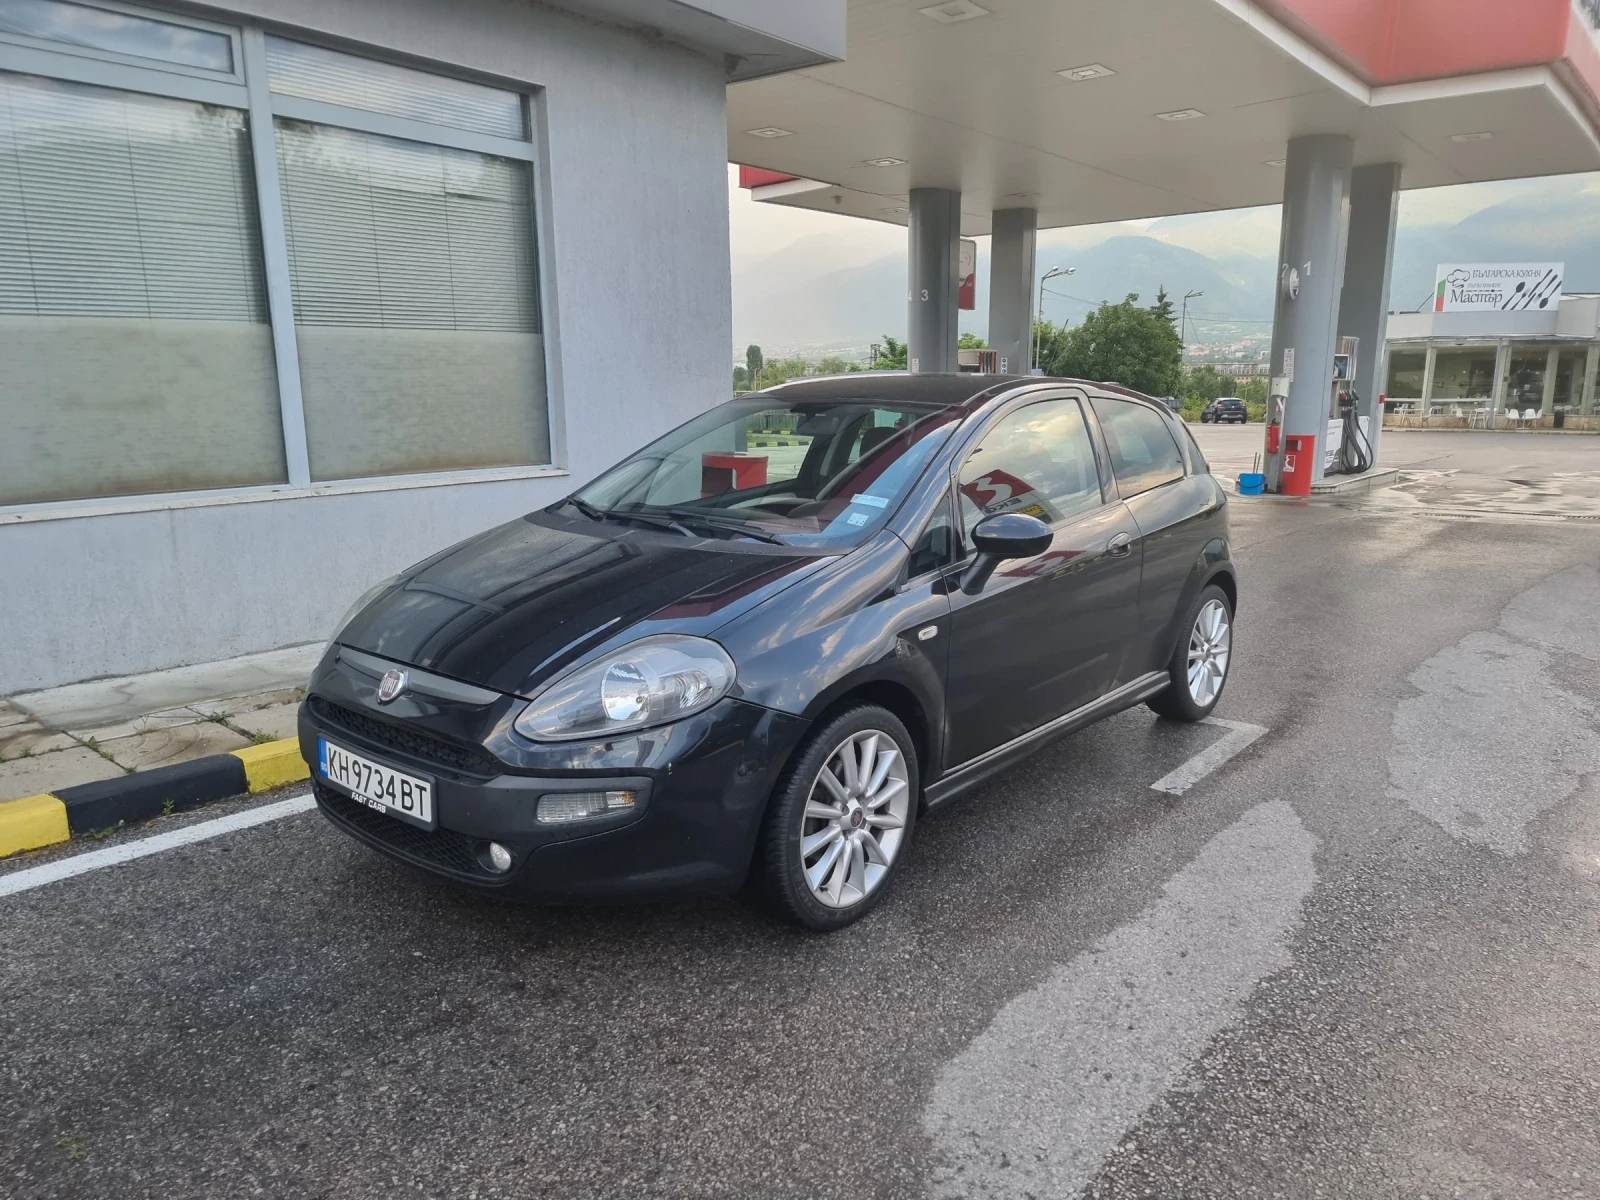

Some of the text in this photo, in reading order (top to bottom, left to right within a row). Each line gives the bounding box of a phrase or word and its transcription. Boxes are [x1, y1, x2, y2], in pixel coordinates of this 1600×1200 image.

[1303, 261, 1311, 275] 1
[1472, 269, 1542, 279] БЪЛГАРСКА КУХНЯ
[921, 289, 929, 301] 3
[1450, 289, 1503, 308] Мастър
[351, 791, 387, 813] FAST CARS
